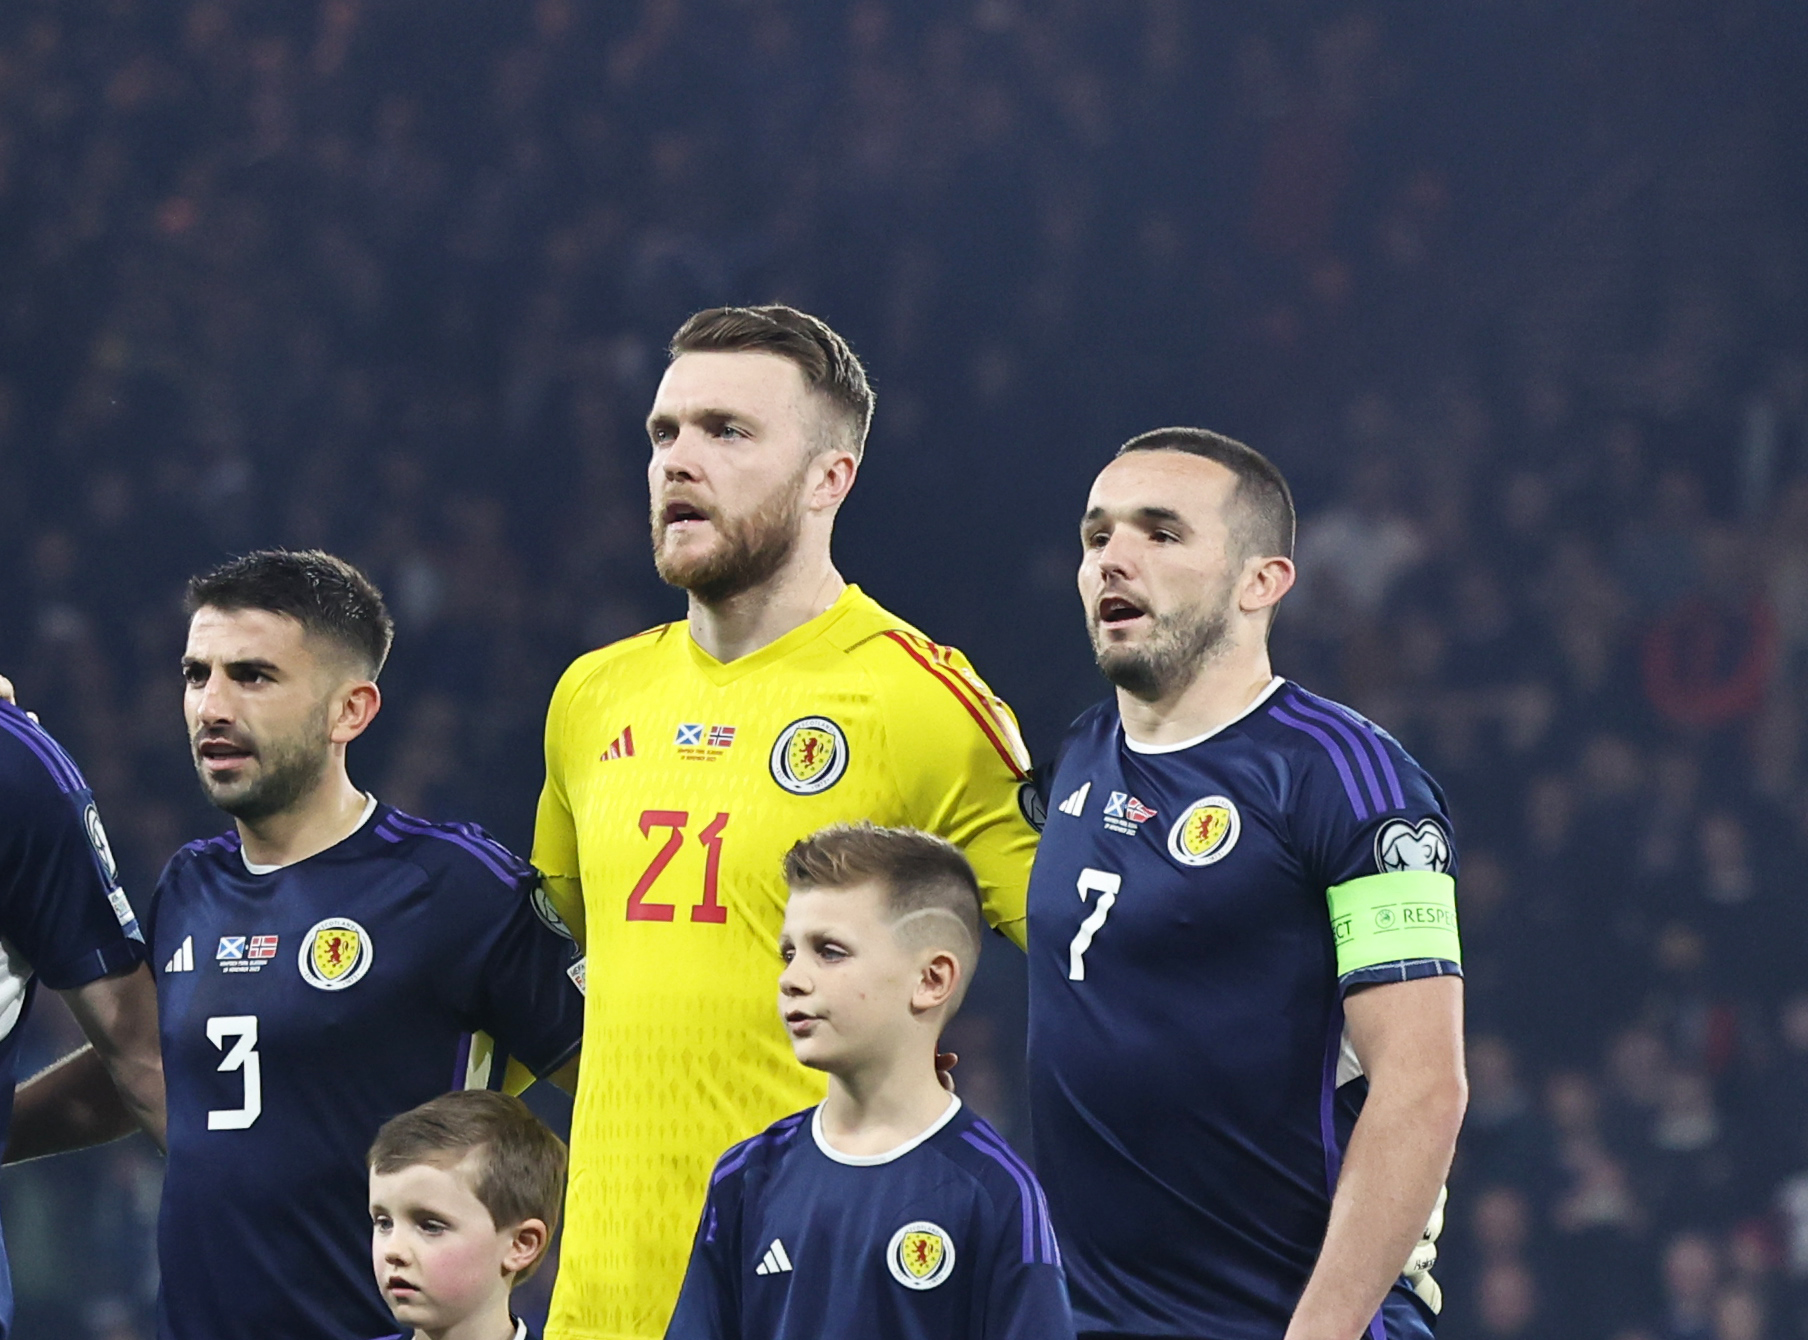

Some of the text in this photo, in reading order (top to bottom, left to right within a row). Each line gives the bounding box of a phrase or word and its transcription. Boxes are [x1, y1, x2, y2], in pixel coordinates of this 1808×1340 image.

[626, 810, 730, 924] 21
[1069, 867, 1122, 981] 7
[1403, 908, 1457, 929] RESPEC
[206, 1015, 262, 1130] 3
